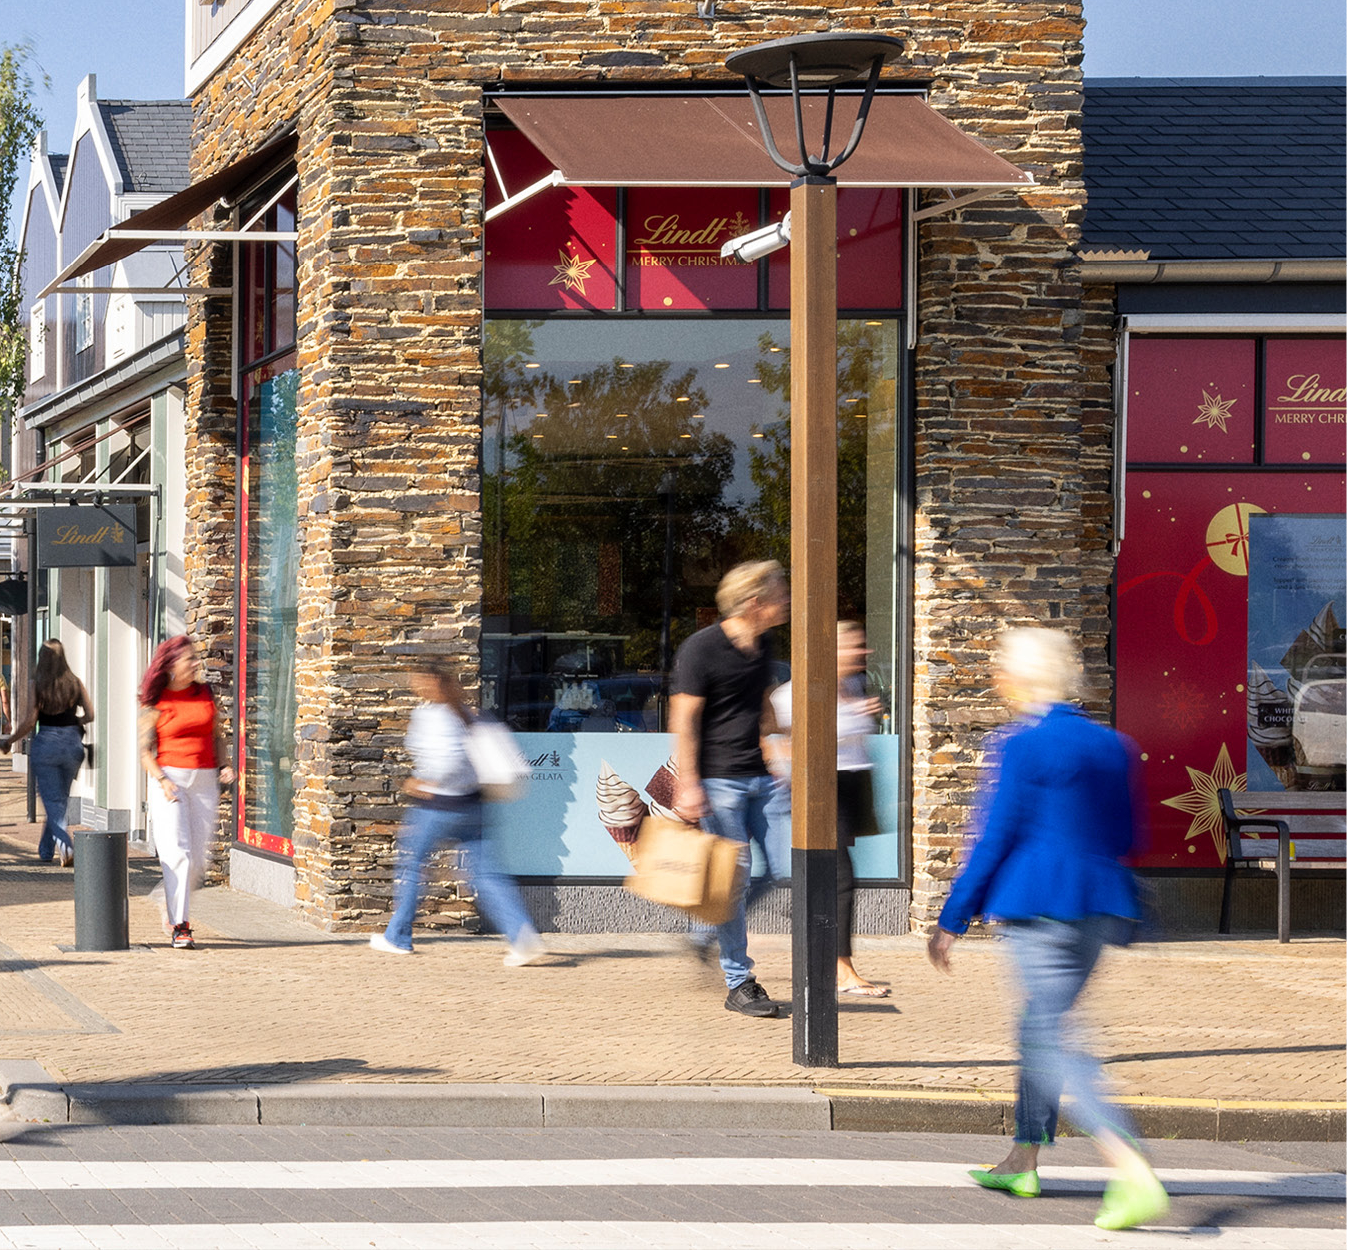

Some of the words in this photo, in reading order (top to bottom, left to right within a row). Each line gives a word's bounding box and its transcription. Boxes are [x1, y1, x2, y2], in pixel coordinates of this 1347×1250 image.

[633, 214, 729, 245] Lindt
[631, 255, 675, 266] MERRY
[677, 255, 754, 267] CHRISTM
[1274, 413, 1316, 424] MERRY
[1318, 413, 1347, 424] CHR
[51, 524, 109, 545] Lindt
[531, 773, 563, 781] GELATA
